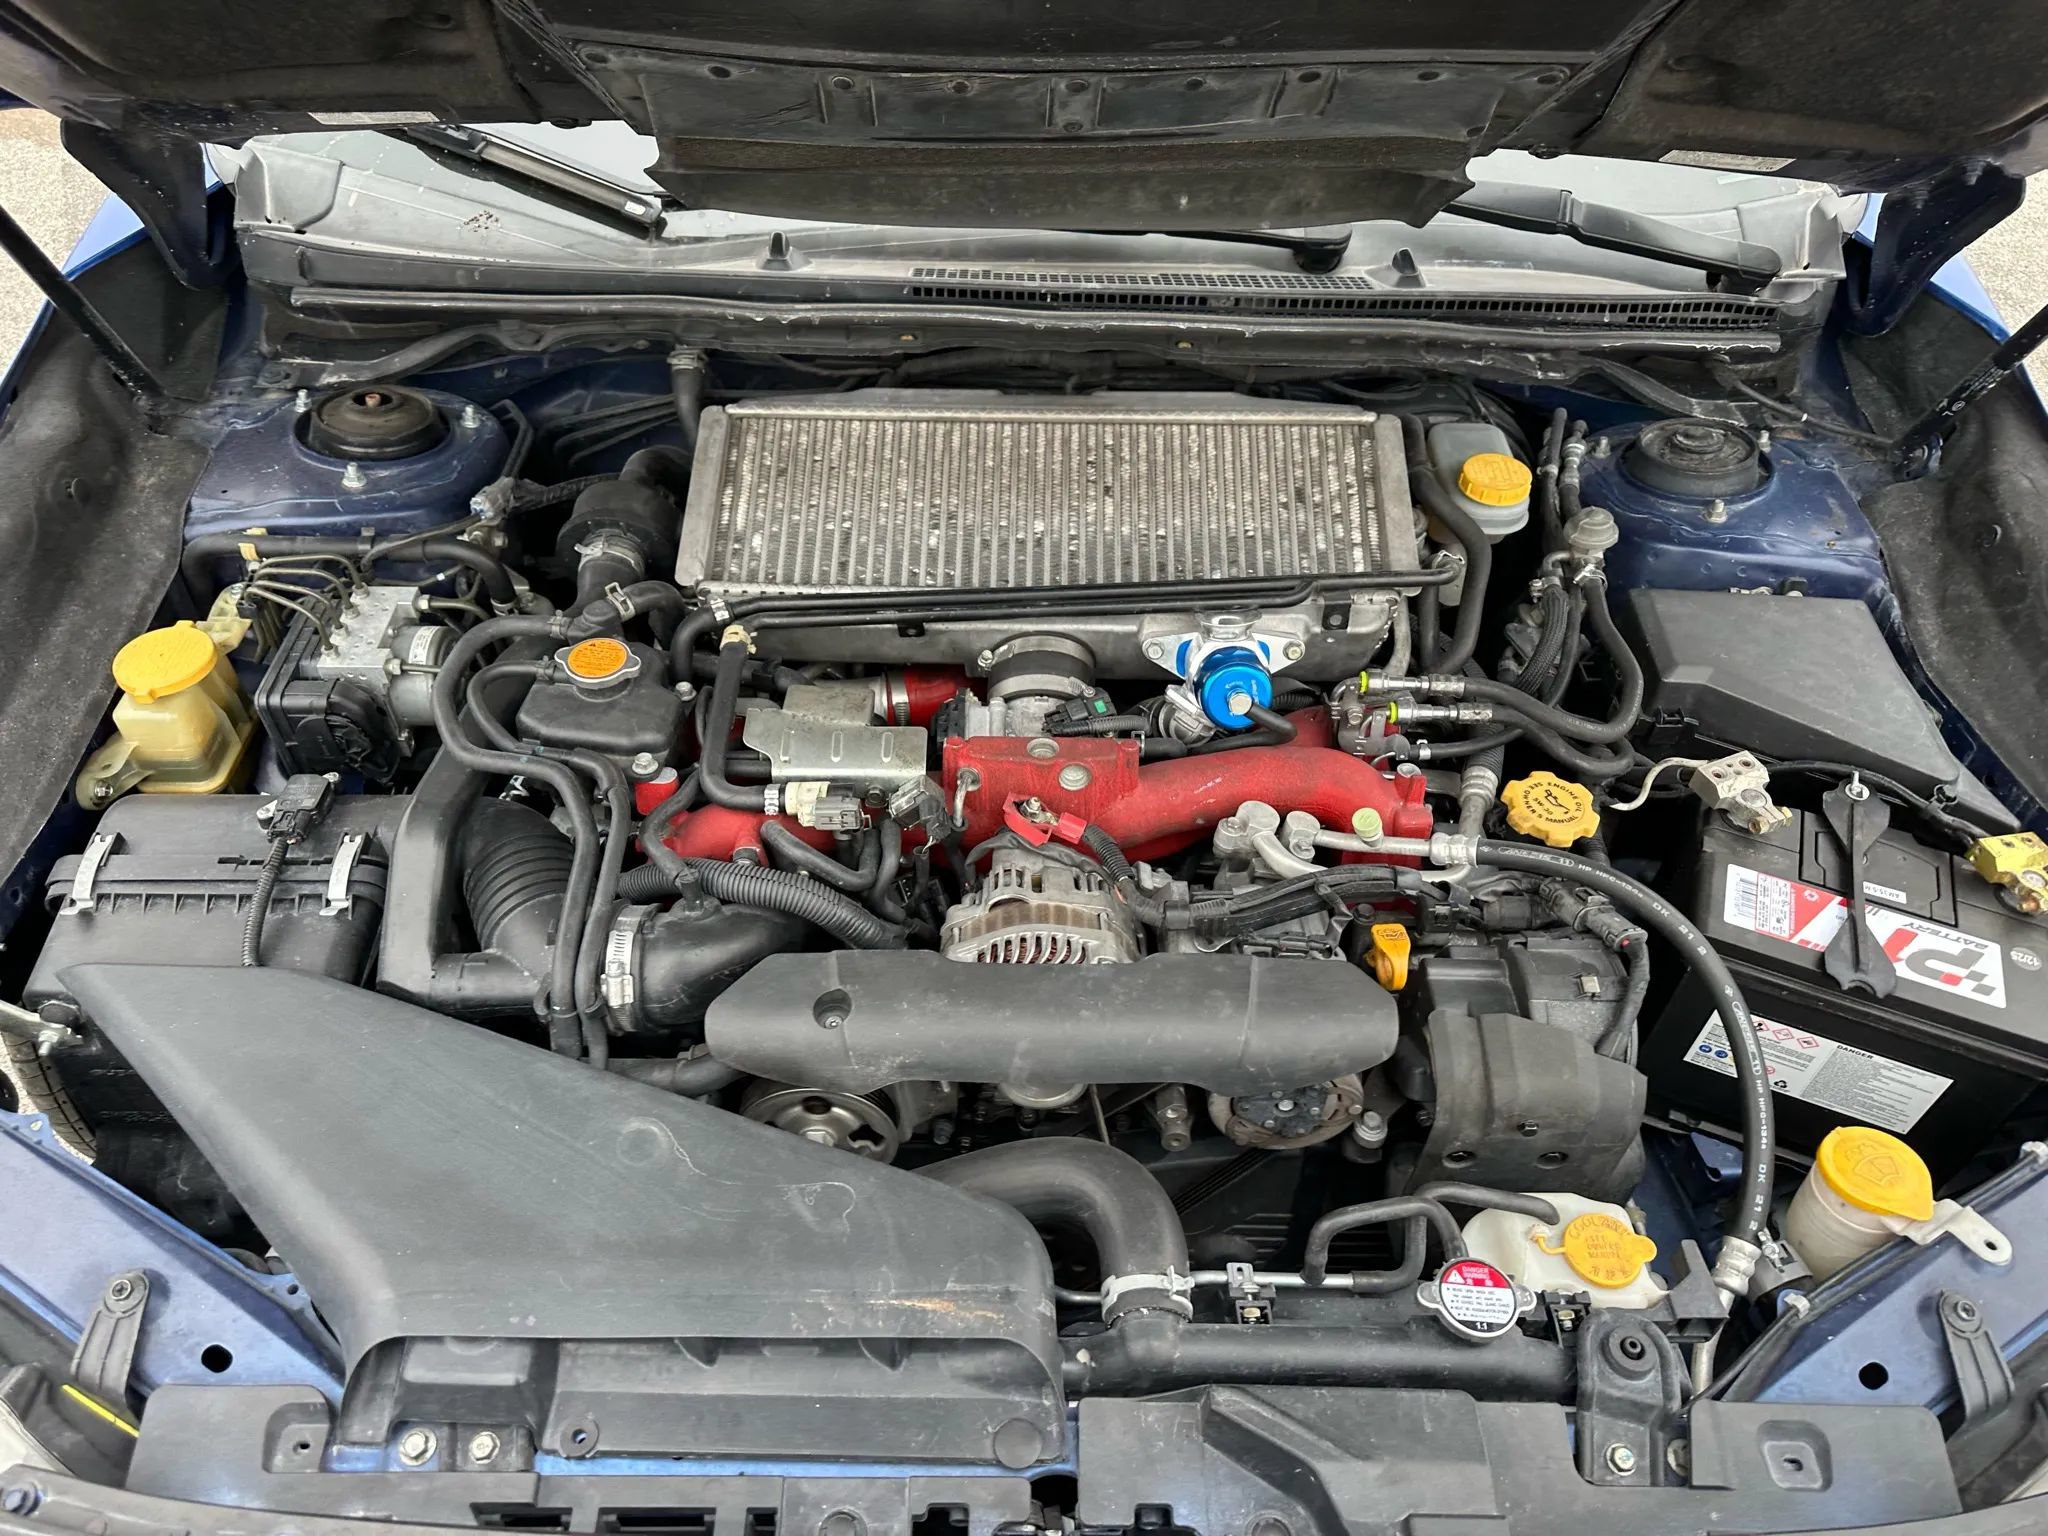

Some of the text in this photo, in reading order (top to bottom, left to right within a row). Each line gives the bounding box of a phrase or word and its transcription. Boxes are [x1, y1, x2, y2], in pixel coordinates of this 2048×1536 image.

[1547, 781, 1579, 800] ENGINE
[1544, 815, 1578, 824] MANUAL
[1578, 863, 1592, 872] HP
[1652, 902, 1671, 918] DK
[1903, 922, 1988, 950] BATTERY
[1836, 1044, 1874, 1060] DANGER
[1756, 1079, 1764, 1094] HP
[1757, 1163, 1767, 1184] DK
